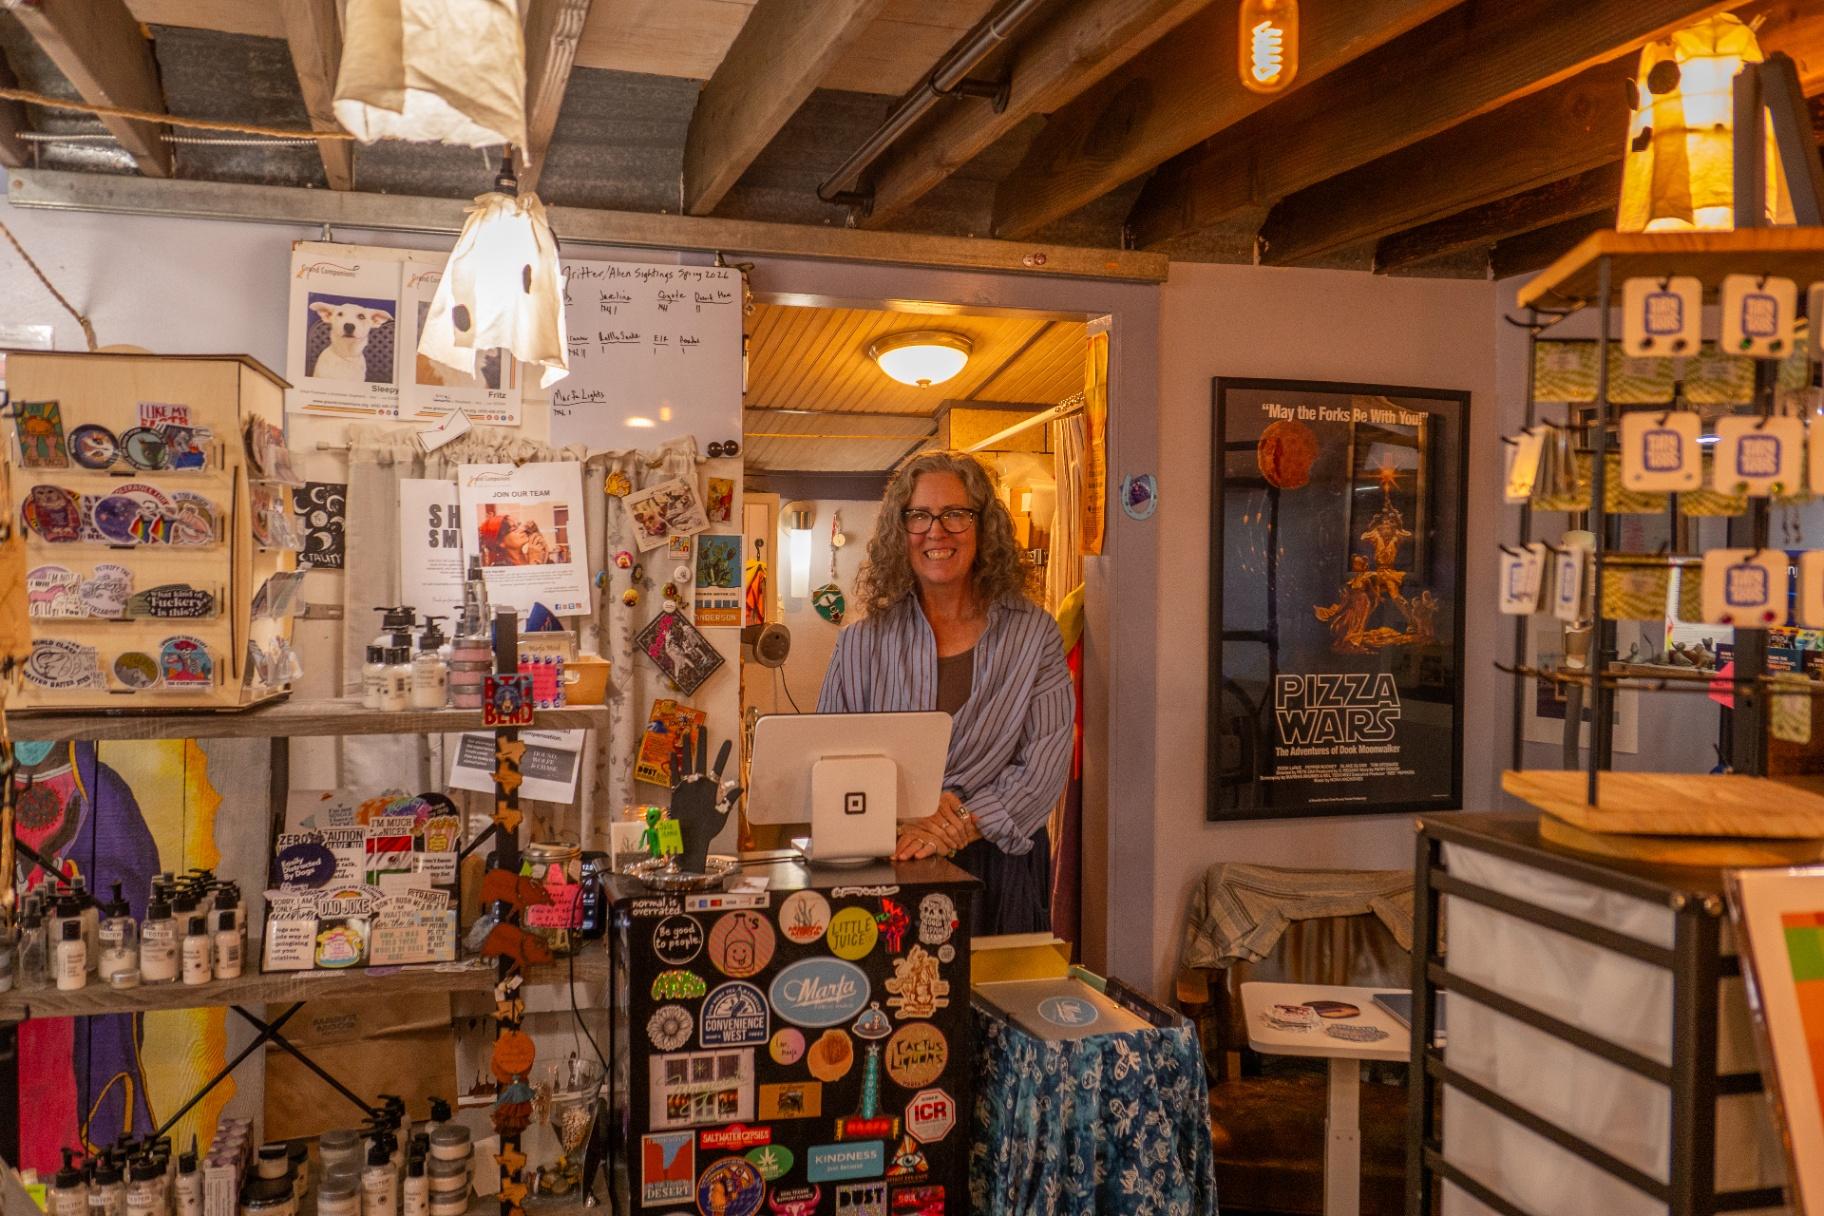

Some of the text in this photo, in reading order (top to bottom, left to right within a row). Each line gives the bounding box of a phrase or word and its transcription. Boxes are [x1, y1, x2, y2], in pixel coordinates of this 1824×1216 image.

[635, 267, 674, 283] Sightings
[705, 269, 729, 280] 2026
[371, 384, 399, 395] Sleepy
[488, 391, 507, 399] Fritz
[553, 390, 606, 403] Marfa Lights
[140, 403, 188, 418] I LIKE MY
[1262, 404, 1429, 426] “May the Forks Be With You!”
[492, 490, 510, 498] JOIN
[529, 489, 550, 497] TEAM
[175, 589, 193, 598] kind
[151, 597, 207, 608] Fuckery
[156, 607, 194, 617] is this?
[1275, 673, 1401, 710] PIZZA
[1275, 708, 1401, 744] WARS
[1275, 743, 1400, 757] The Adventures of Dook Moonwalker
[371, 817, 413, 827] I'M MUCH
[279, 833, 308, 846] ZERO
[281, 857, 304, 868] Easily
[282, 858, 322, 875] Distracted
[284, 868, 315, 882] By Dogs
[321, 899, 371, 916] DAD JOKE
[632, 897, 678, 908] normal is
[632, 906, 682, 917] overrated.
[659, 923, 696, 938] Be good
[831, 918, 872, 937] LITTLE
[655, 938, 701, 952] to people.
[833, 934, 866, 950] JUICE
[786, 975, 856, 1002] Marfa
[705, 1016, 765, 1032] CONVENIENCE
[723, 1029, 747, 1042] WEST
[914, 1101, 948, 1122] ICR
[702, 1132, 741, 1143] SALTWATER
[815, 1151, 877, 1164] KINDNESS
[647, 1185, 689, 1199] DESERT
[838, 1187, 884, 1208] DUST
